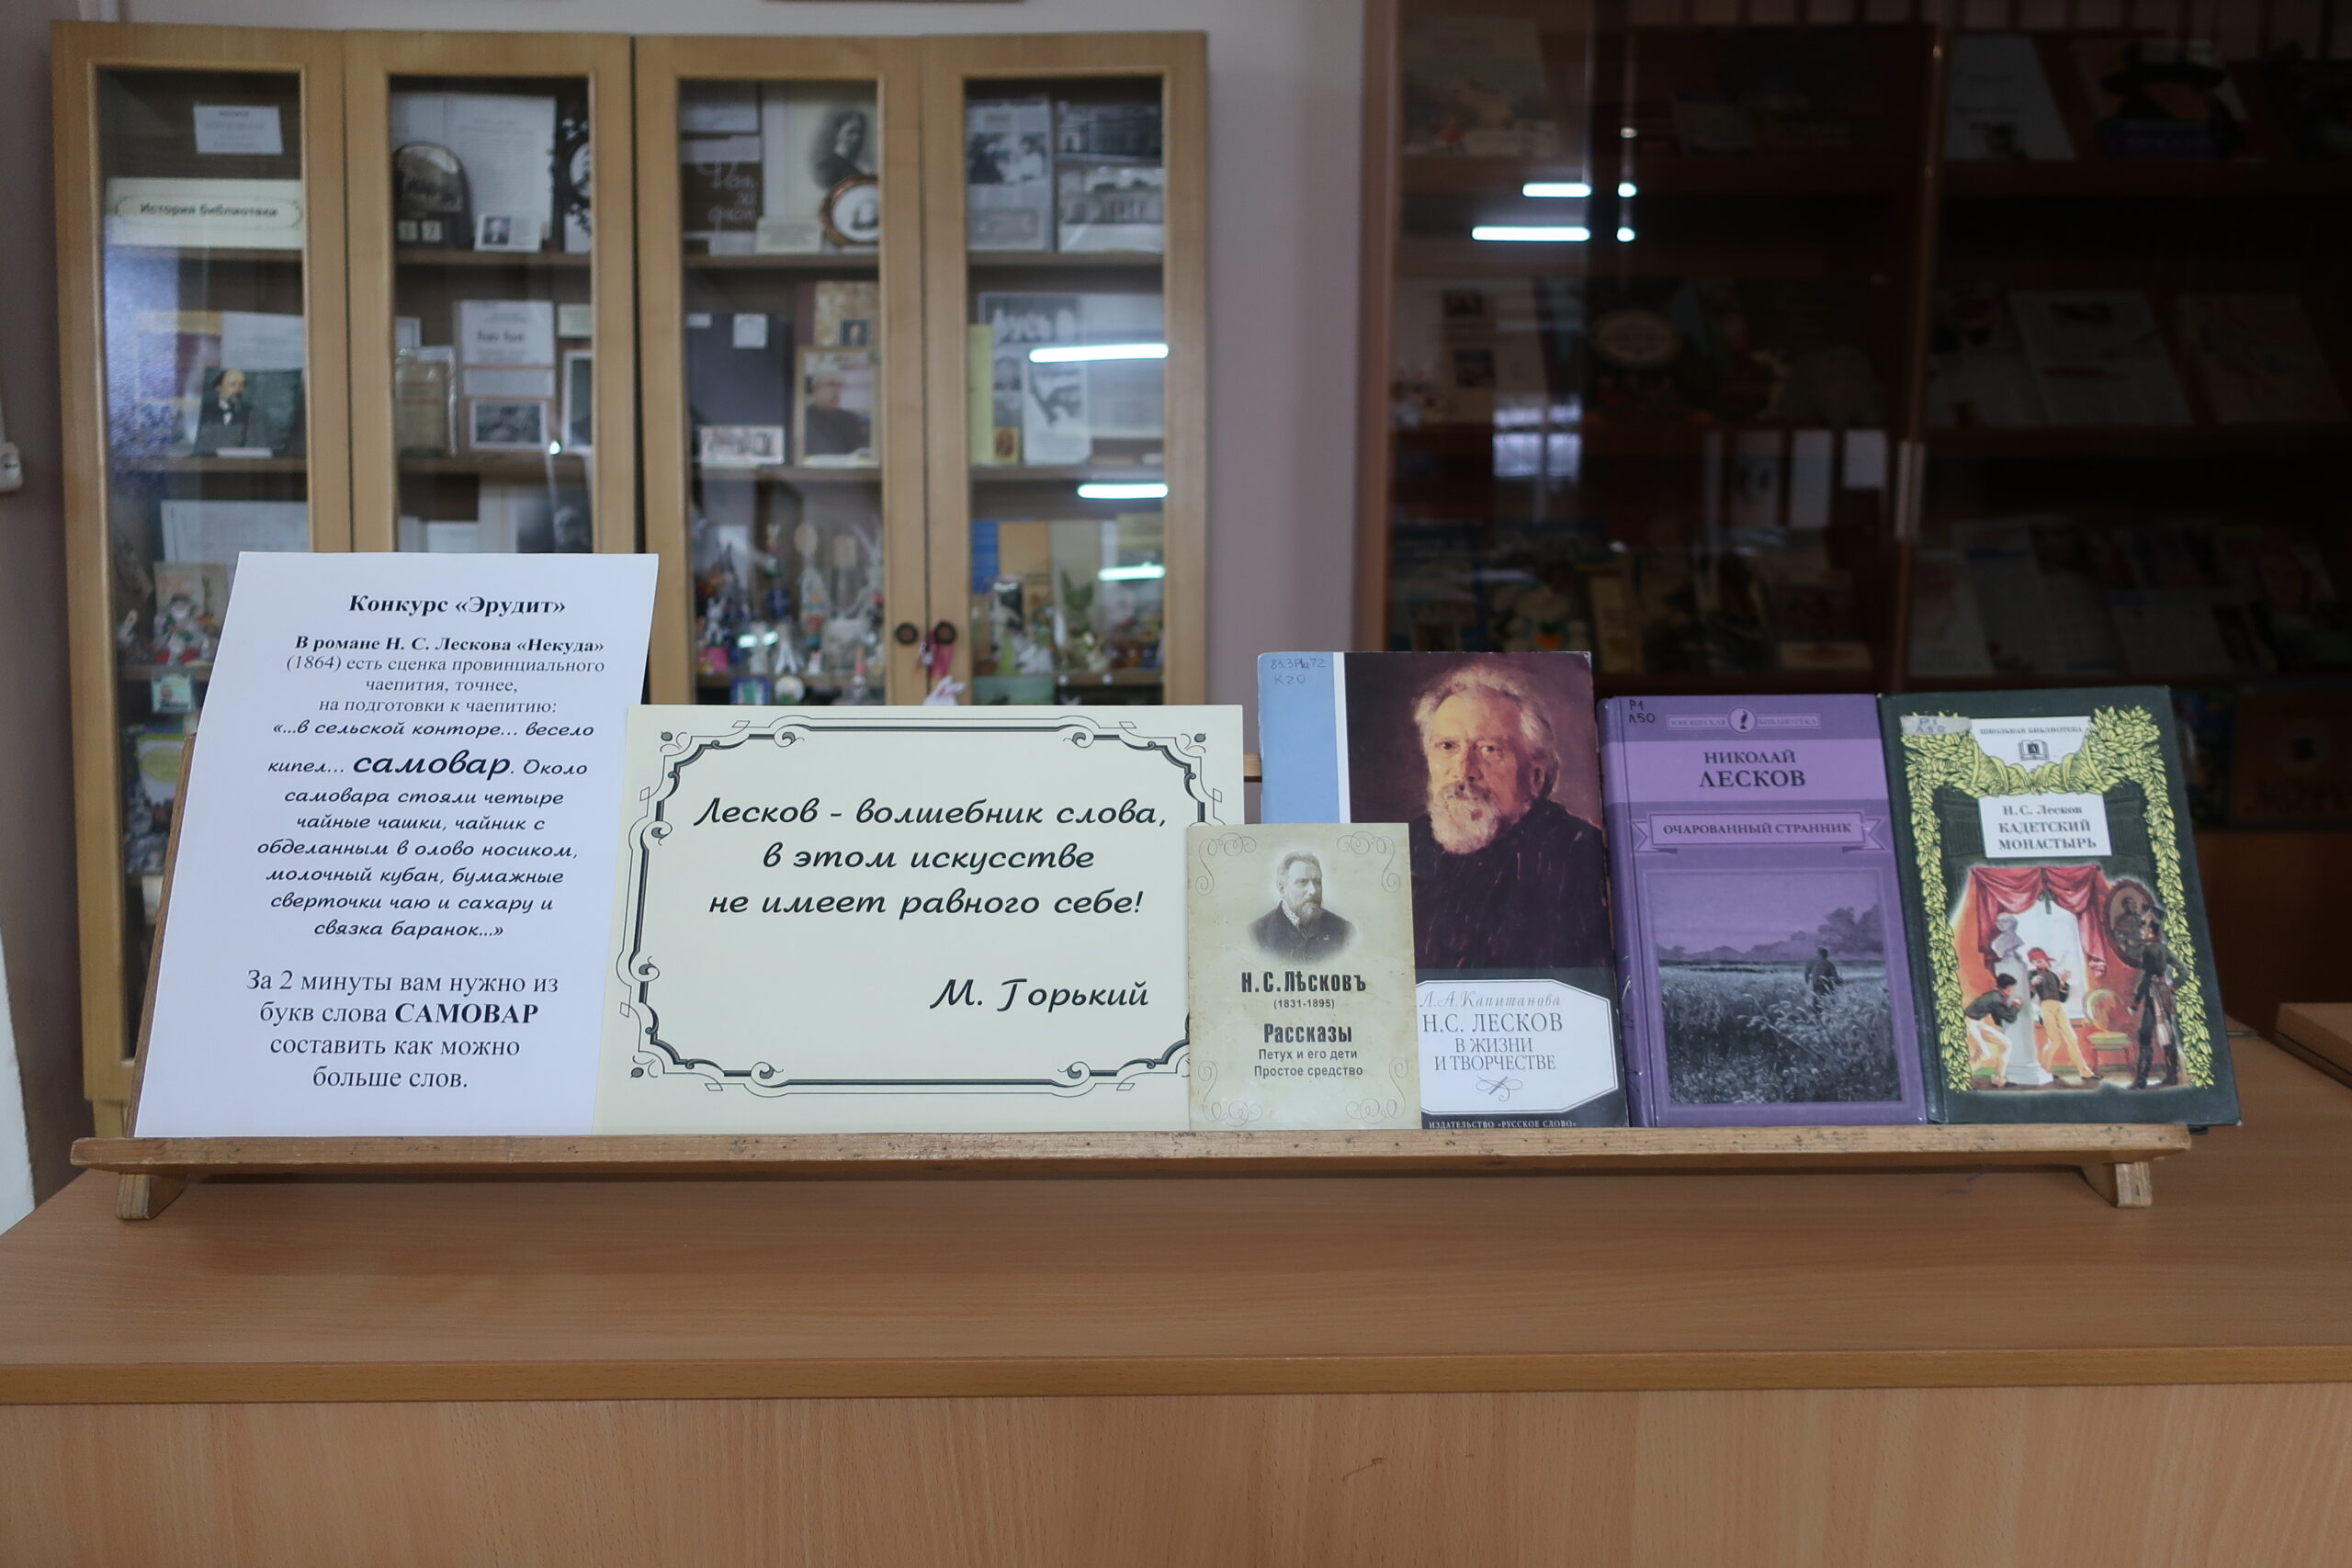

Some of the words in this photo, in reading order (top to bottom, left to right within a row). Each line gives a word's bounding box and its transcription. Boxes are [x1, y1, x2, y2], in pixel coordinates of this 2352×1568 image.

[348, 594, 448, 616] Конкурс
[455, 596, 566, 617] «Эрудит»
[295, 636, 308, 649] В
[313, 638, 379, 652] романе
[385, 637, 405, 650] Н.
[411, 637, 430, 651] С.
[435, 637, 511, 651] Лескова
[517, 637, 604, 654] «Некуда»
[286, 655, 342, 672] (1864)
[346, 660, 382, 671] есть
[388, 660, 446, 672] сценка
[451, 660, 605, 673] провинциального
[366, 680, 449, 694] чаепития,
[456, 681, 518, 694] точнее,
[319, 701, 339, 711] на
[345, 701, 444, 714] подготовки
[450, 702, 460, 712] к
[465, 701, 558, 715] чаепитию:
[314, 721, 404, 736] сельской
[526, 721, 594, 737] весело
[2029, 726, 2082, 734] БИБЛИОТЕКА
[353, 750, 514, 780] самовар.
[523, 759, 588, 775] Около
[1703, 749, 1797, 765] НИКОЛАЙ
[1699, 770, 1806, 787] ЛЕСКОВ
[284, 787, 390, 806] самовара
[398, 792, 477, 804] стояли
[484, 793, 564, 807] четыре
[694, 797, 821, 827] Лесков
[855, 798, 1044, 826] волшебник
[1055, 798, 1167, 828] слова,
[2002, 806, 2018, 816] Н.
[2020, 806, 2033, 816] С.
[2036, 805, 2083, 815] Лесков
[297, 814, 370, 829] чайные
[378, 818, 447, 831] чашки,
[455, 815, 526, 830] чайник
[534, 818, 545, 830] с
[1662, 822, 1773, 835] ОЧАРОВАННЫЙ
[1775, 822, 1852, 834] СТРАННИК
[1998, 818, 2091, 834] КАДЕТСКИЙ
[257, 839, 389, 856] обделанным
[396, 840, 408, 855] в
[414, 841, 474, 856] олово
[481, 845, 579, 859] носиком,
[1999, 838, 2097, 851] МОНАСТЫРЬ
[763, 842, 783, 869] в
[793, 849, 898, 869] этом
[910, 842, 1095, 875] искусстве
[266, 867, 372, 882] молочный
[379, 868, 445, 886] кубан,
[452, 867, 563, 886] бумажные
[270, 892, 381, 911] сверточки
[390, 897, 430, 910] чаю
[438, 897, 450, 909] и
[458, 897, 533, 913] сахару
[540, 898, 553, 910] и
[708, 895, 749, 914] не
[762, 895, 887, 915] имеет
[899, 888, 1040, 920] равного
[1053, 887, 1144, 915] себе!
[314, 919, 383, 935] связка
[245, 969, 272, 990] За
[278, 969, 293, 990] 2
[301, 975, 392, 996] минуты
[400, 977, 442, 992] вам
[449, 977, 526, 997] нужно
[533, 977, 559, 993] из
[929, 978, 985, 1010] М.
[996, 977, 1149, 1013] Горький
[1273, 998, 1335, 1010] (1831-1895)
[260, 1001, 314, 1026] букв
[322, 1007, 387, 1023] слова
[394, 1002, 538, 1024] САМОВАР
[1422, 1013, 1464, 1032] Н.С.
[1472, 1012, 1563, 1032] ЛЕСКОВ
[1263, 1022, 1352, 1043] Рассказы
[270, 1038, 386, 1055] составить
[393, 1040, 433, 1055] как
[440, 1040, 520, 1056] можно
[1454, 1038, 1465, 1053] В
[1470, 1037, 1532, 1053] ЖИЗНИ
[1259, 1048, 1294, 1062] Петух
[1296, 1051, 1304, 1059] и
[1307, 1050, 1327, 1059] его
[1329, 1050, 1358, 1060] дети
[1434, 1055, 1447, 1070] И
[1449, 1055, 1556, 1071] ТВОРЧЕСТВЕ
[313, 1066, 401, 1088] больше
[409, 1072, 468, 1089] слов.
[1254, 1065, 1304, 1079] Простое
[1307, 1066, 1363, 1078] средство
[1429, 1121, 1495, 1129] ИЗДАТЕЛЬСТВО
